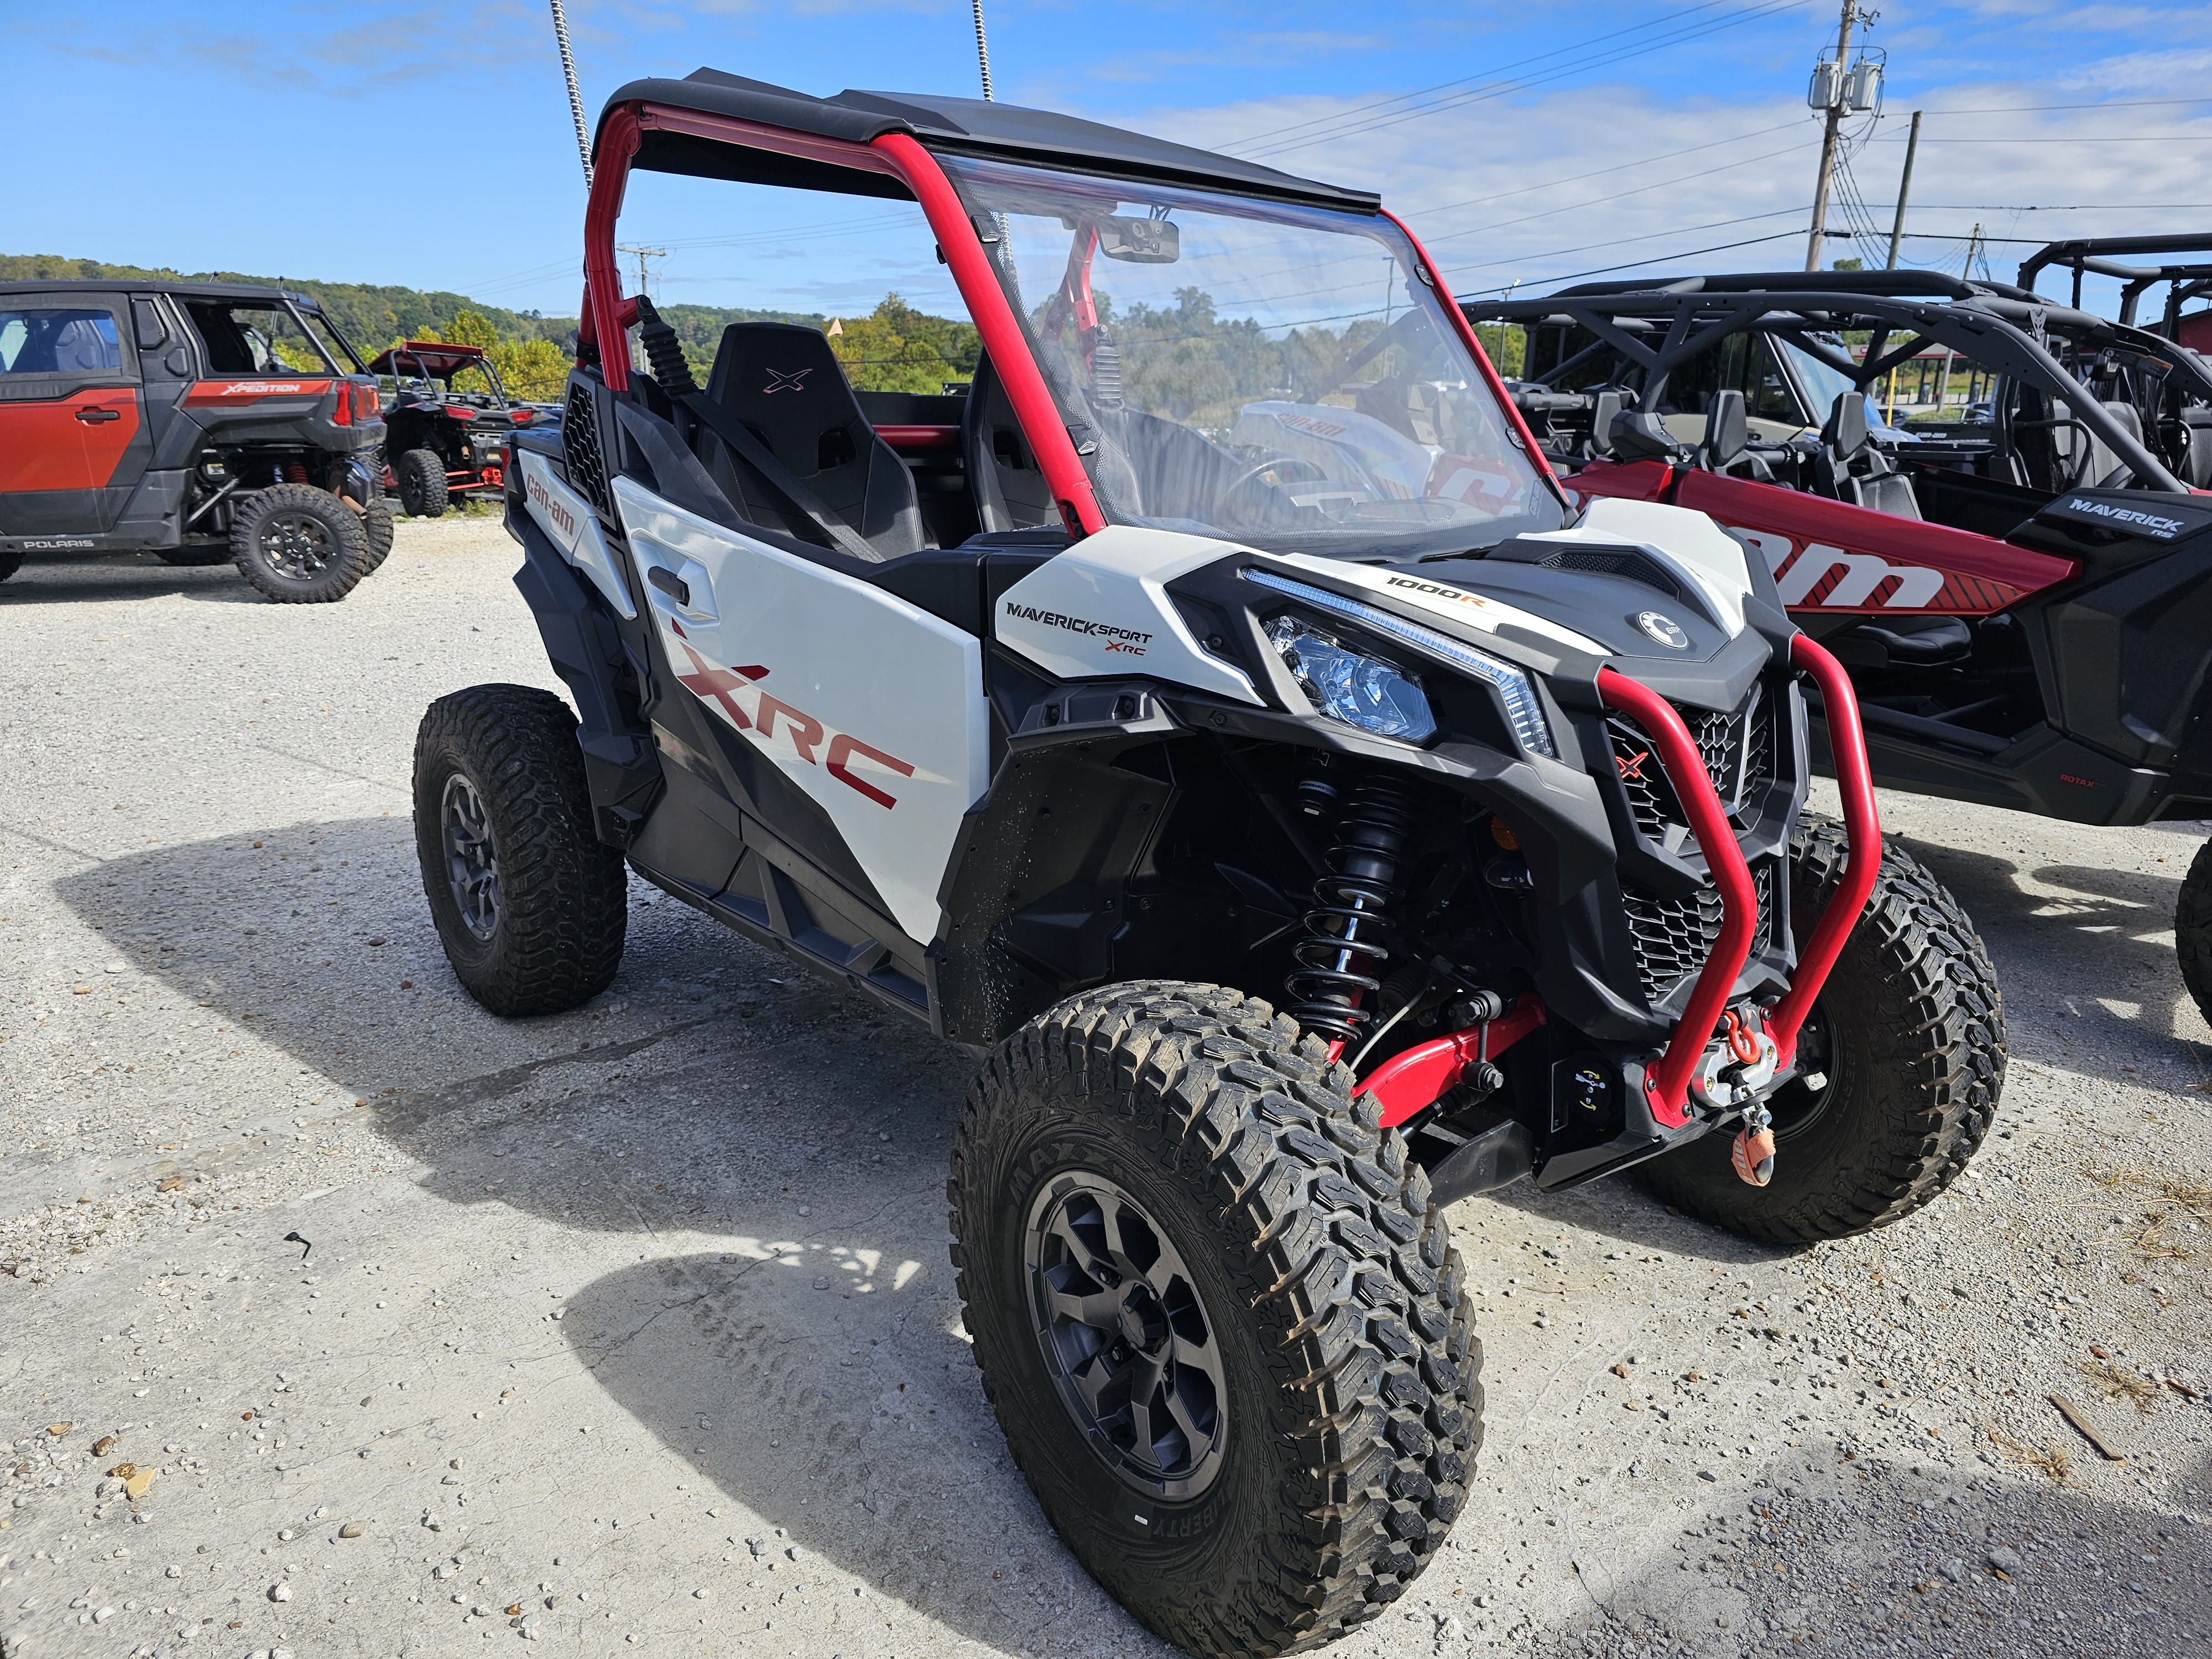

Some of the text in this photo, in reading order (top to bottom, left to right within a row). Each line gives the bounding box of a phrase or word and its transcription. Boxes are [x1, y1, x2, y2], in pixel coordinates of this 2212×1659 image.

[220, 382, 300, 396] XPEDITION
[527, 473, 575, 536] can-am
[2069, 498, 2184, 533] MAVERICK
[2151, 529, 2174, 539] RS
[23, 540, 95, 549] POLARIS
[1386, 577, 1486, 608] 1000R
[1665, 626, 1681, 634] BRP
[1105, 639, 1146, 656] XRC
[671, 617, 915, 810] XRC
[2060, 774, 2094, 787] ROTAX
